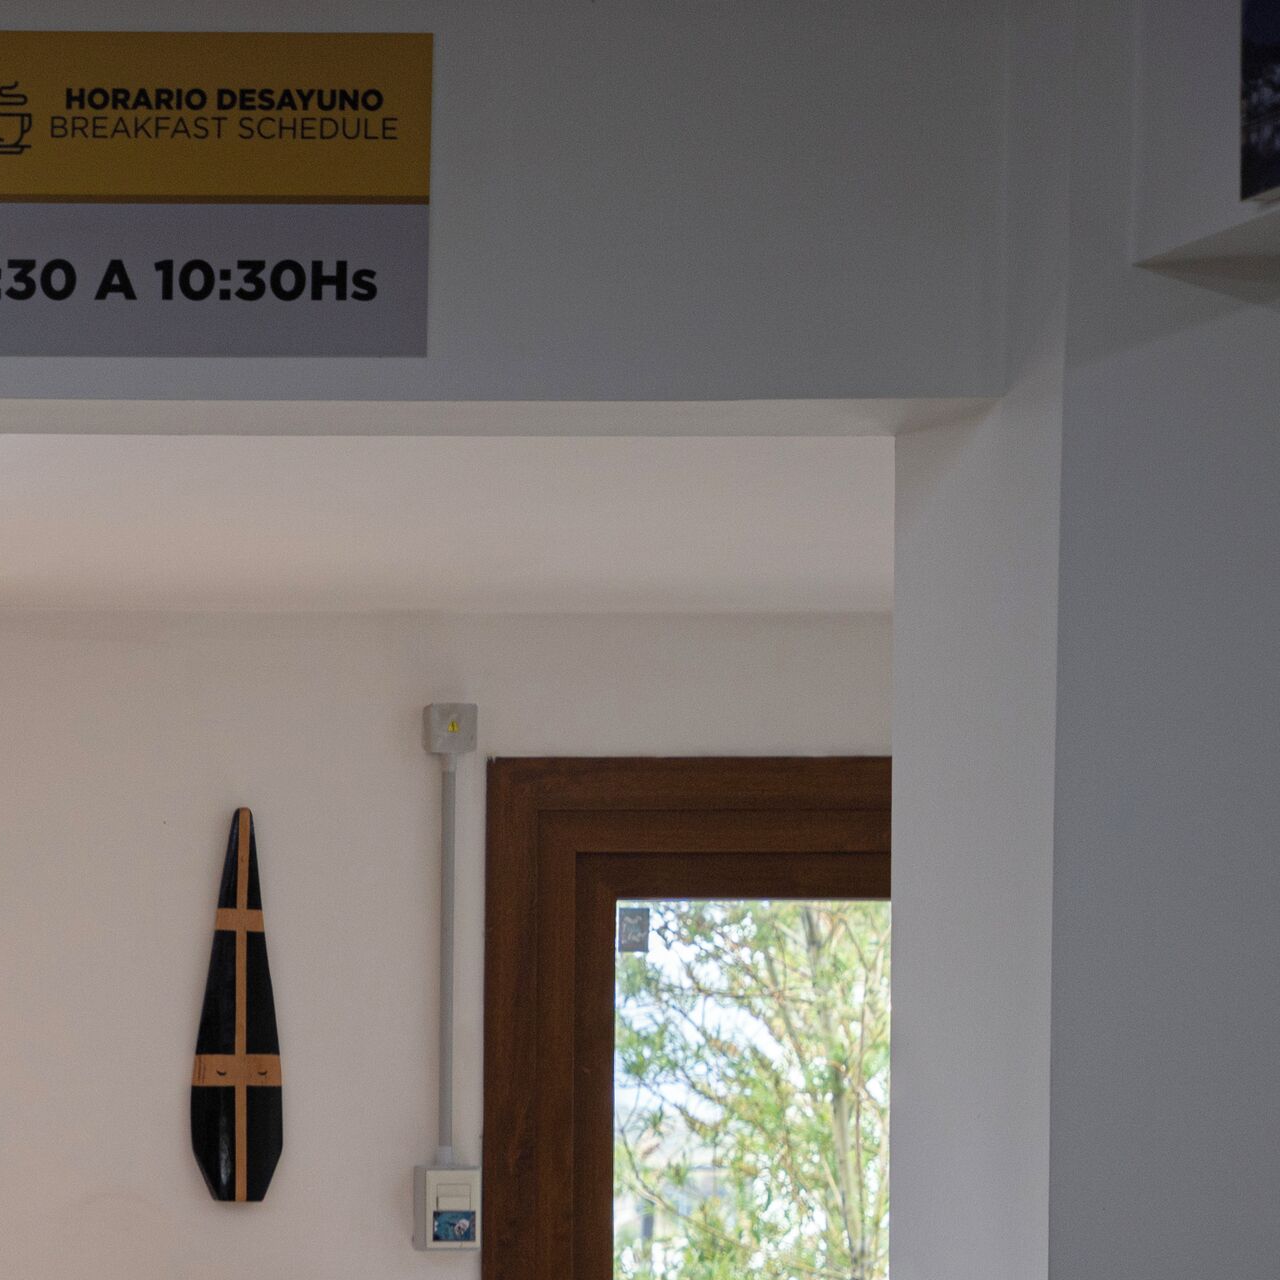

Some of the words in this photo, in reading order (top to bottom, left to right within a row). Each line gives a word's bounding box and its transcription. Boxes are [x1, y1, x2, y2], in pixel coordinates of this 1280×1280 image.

[66, 88, 207, 110] HORARIO
[217, 89, 383, 111] DESAYUNO
[51, 116, 228, 139] BREAKFAST
[238, 117, 398, 140] SCHEDULE
[95, 259, 137, 300] A
[154, 259, 377, 301] 10:30Hs
